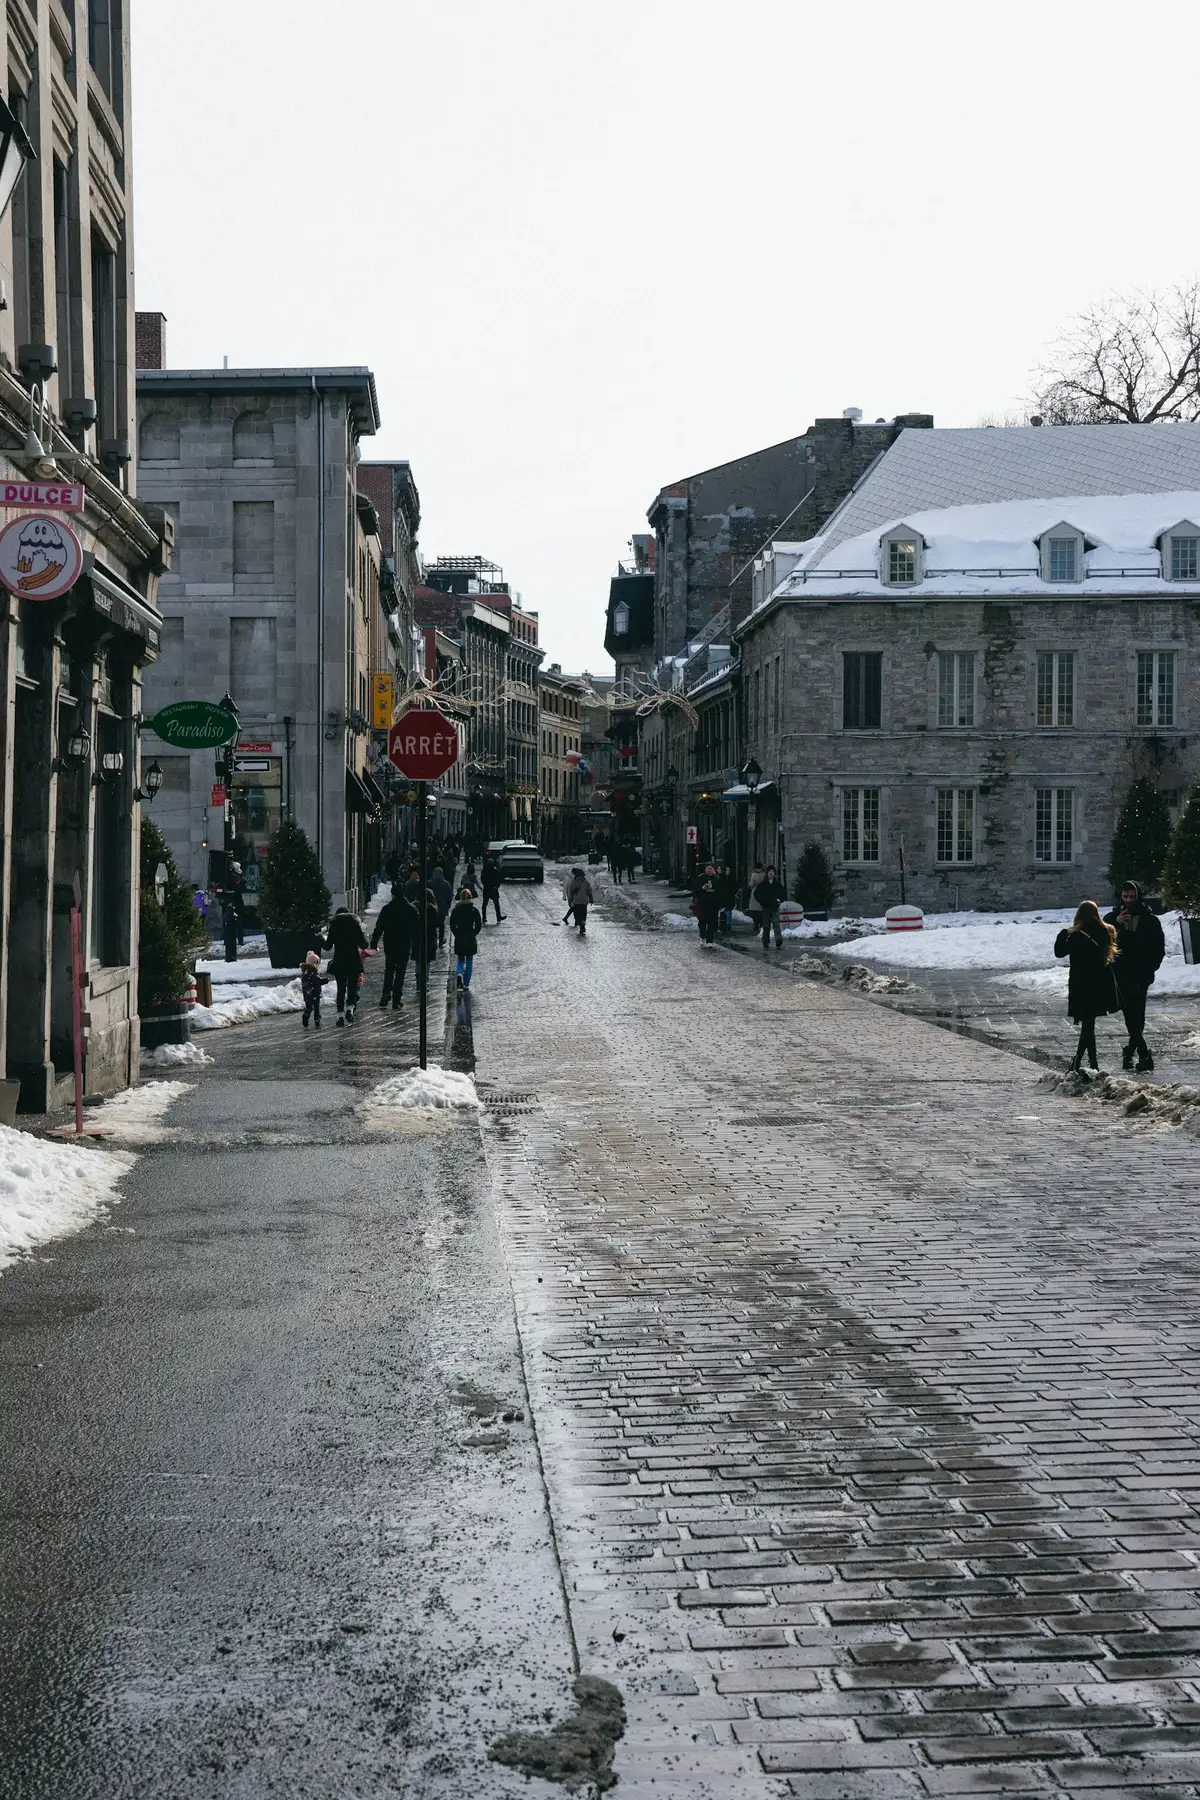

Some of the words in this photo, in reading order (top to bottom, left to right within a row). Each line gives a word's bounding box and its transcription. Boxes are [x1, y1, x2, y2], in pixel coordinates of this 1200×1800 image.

[5, 485, 73, 505] DULCE
[161, 703, 199, 718] RESTAURANT
[167, 716, 225, 738] Paradiso
[391, 732, 456, 757] ARRÊT
